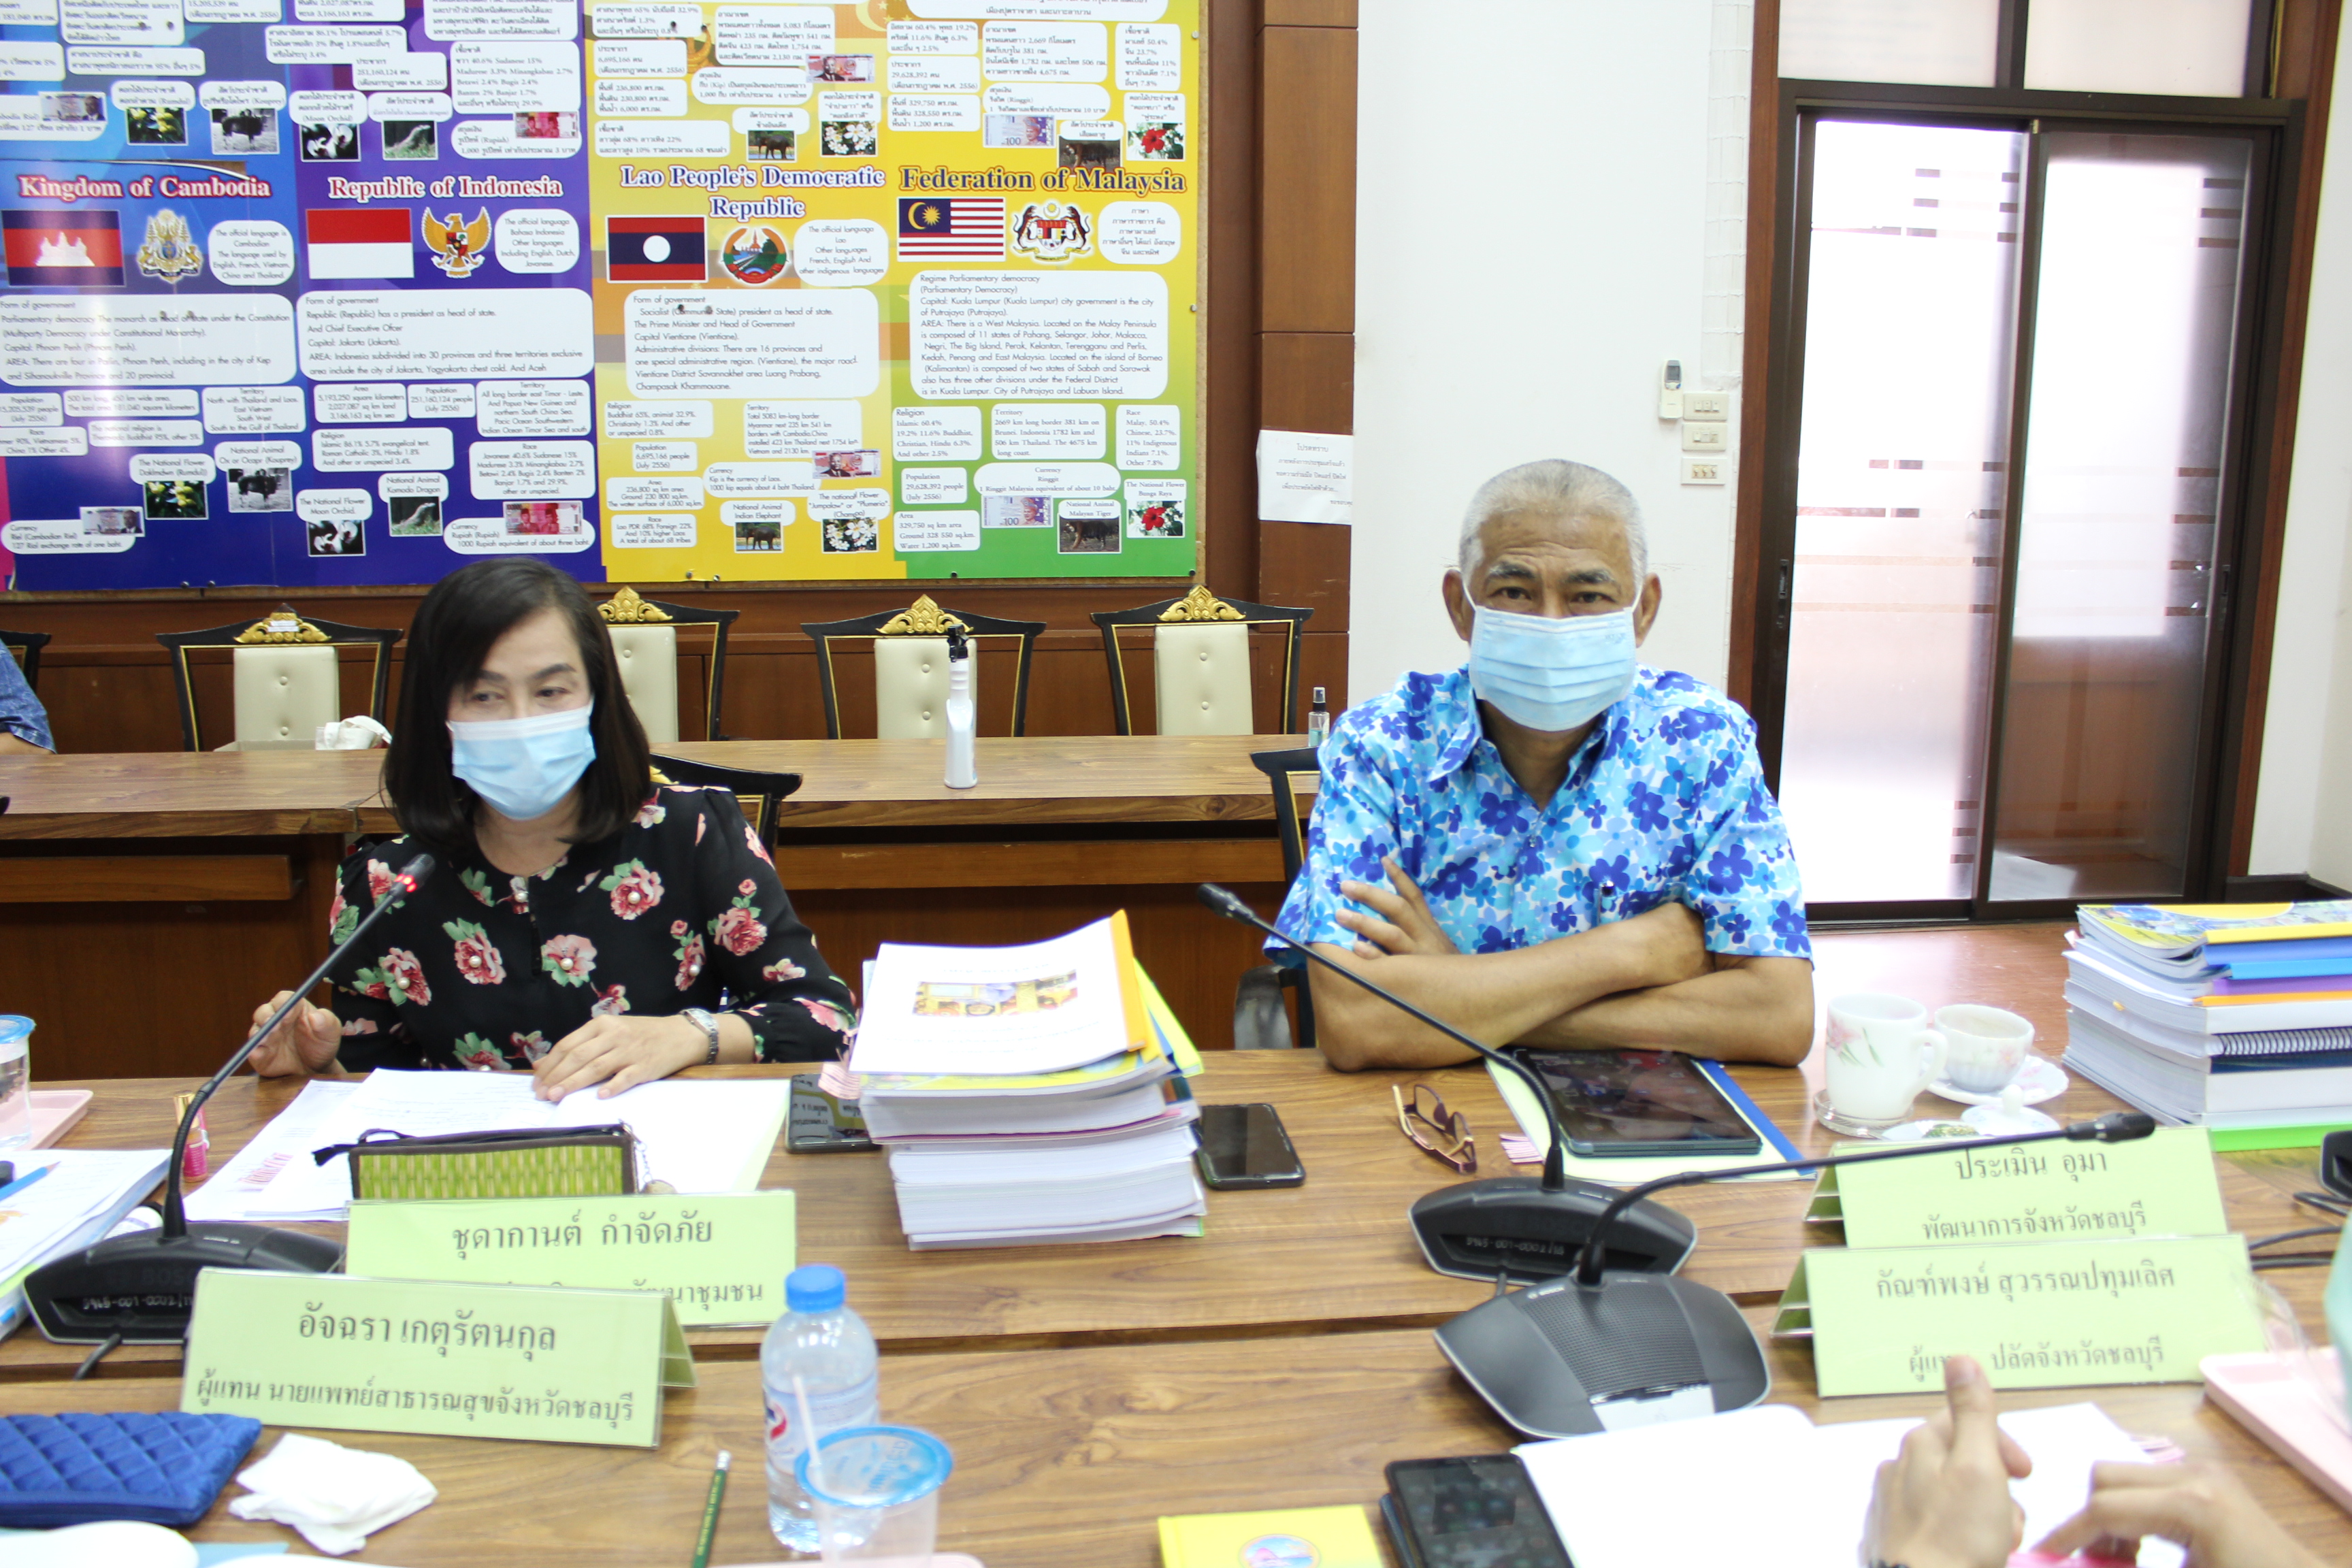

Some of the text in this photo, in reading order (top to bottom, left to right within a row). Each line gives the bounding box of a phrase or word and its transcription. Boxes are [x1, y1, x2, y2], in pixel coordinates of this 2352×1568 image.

[621, 165, 885, 191] Lao People's Democratic
[900, 166, 1185, 196] Federation of Malaysia
[19, 176, 271, 201] Kingdom of Cambodia
[329, 176, 564, 202] Republic of Indonesia
[710, 197, 806, 221] Republic
[920, 274, 1041, 284] Regime Parliamentary democracy
[920, 284, 1018, 295] (Parliamentary Democracy)
[306, 295, 379, 307] Form of government
[633, 295, 706, 306] Form of government
[951, 296, 973, 305] Kuala
[975, 297, 1001, 306] Lumpur
[1003, 296, 1027, 306] (Kuala
[1030, 297, 1058, 306] Lumpur)
[1061, 297, 1074, 306] city
[1075, 298, 1117, 307] government
[1128, 297, 1139, 306] the
[1141, 299, 1154, 307] city
[306, 310, 337, 321] Republic
[340, 309, 376, 320] (Republic)
[378, 309, 391, 318] has
[401, 308, 434, 319] president
[447, 308, 466, 317] head
[468, 308, 476, 316] of
[920, 308, 928, 316] of
[930, 308, 965, 318] Putrajaya
[308, 323, 403, 333] And Chief Executive Ofcer
[634, 320, 647, 328] The
[703, 319, 717, 328] and
[719, 319, 739, 328] Head
[741, 319, 749, 328] of
[751, 320, 796, 328] Government
[946, 318, 966, 327] There
[1043, 318, 1071, 327] Located
[1085, 318, 1096, 327] the
[1098, 319, 1121, 329] Malay
[1124, 319, 1157, 328] Peninsula
[338, 338, 365, 346] Jakarta
[634, 332, 660, 342] Capital
[671, 370, 696, 378] District
[698, 369, 744, 378] Savannakhet
[765, 370, 787, 379] Luang
[921, 376, 936, 384] also
[938, 375, 952, 384] has
[954, 375, 973, 384] three
[975, 375, 993, 384] other
[996, 375, 1026, 383] divisions
[1028, 375, 1049, 383] under
[1051, 375, 1063, 383] the
[1065, 375, 1092, 383] Federal
[636, 382, 679, 392] Champasak
[895, 407, 925, 419] Religion
[1143, 440, 1177, 448] Indigenous
[906, 473, 941, 482] Population
[1037, 476, 1059, 484] Ringgit
[943, 483, 964, 491] people
[906, 493, 921, 502] (July
[755, 512, 781, 520] Elephant
[1955, 1146, 2108, 1183] ประเมิน อุมา
[1922, 1200, 2147, 1239] พัฒนาการจังหวัดชลบุรี
[453, 1209, 713, 1260] ชุดากานต์ กำจัดภัย
[1998, 1258, 2176, 1302] สุวรรณปทุมเลิศ
[299, 1301, 556, 1361] อัจฉรา เกตุรัตนกุล
[1991, 1335, 2164, 1371] ปลัดจังหวัดชลบุรี
[197, 1368, 634, 1429] ผู้แทน นายแพทย์สาธารณสุขจังหวัดชลบุรี
